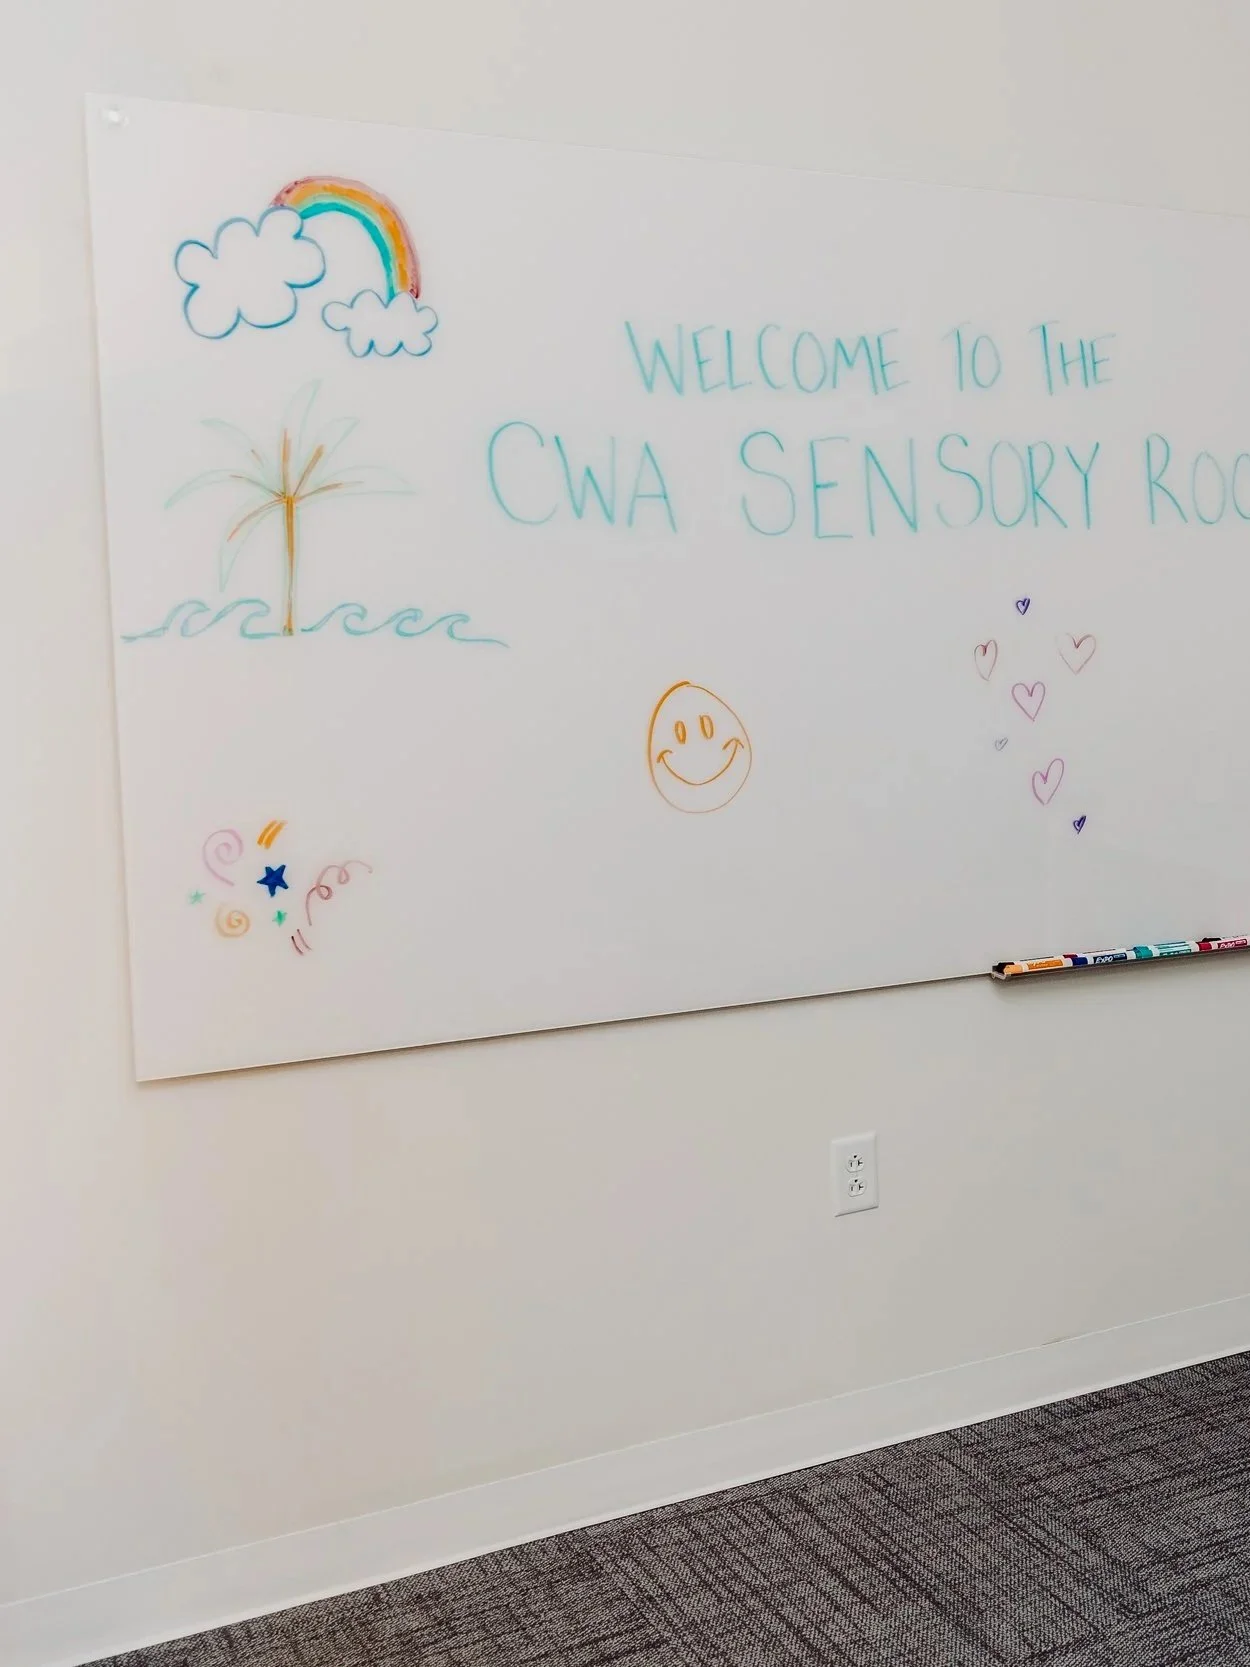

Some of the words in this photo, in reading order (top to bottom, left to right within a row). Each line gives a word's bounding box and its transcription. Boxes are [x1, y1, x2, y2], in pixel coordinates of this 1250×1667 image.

[622, 320, 911, 398] WELCOME
[950, 321, 1002, 393] TO
[1028, 320, 1117, 397] THE
[486, 419, 678, 534] CWA
[739, 429, 1101, 540] SENSORY
[1095, 955, 1114, 964] EXPO
